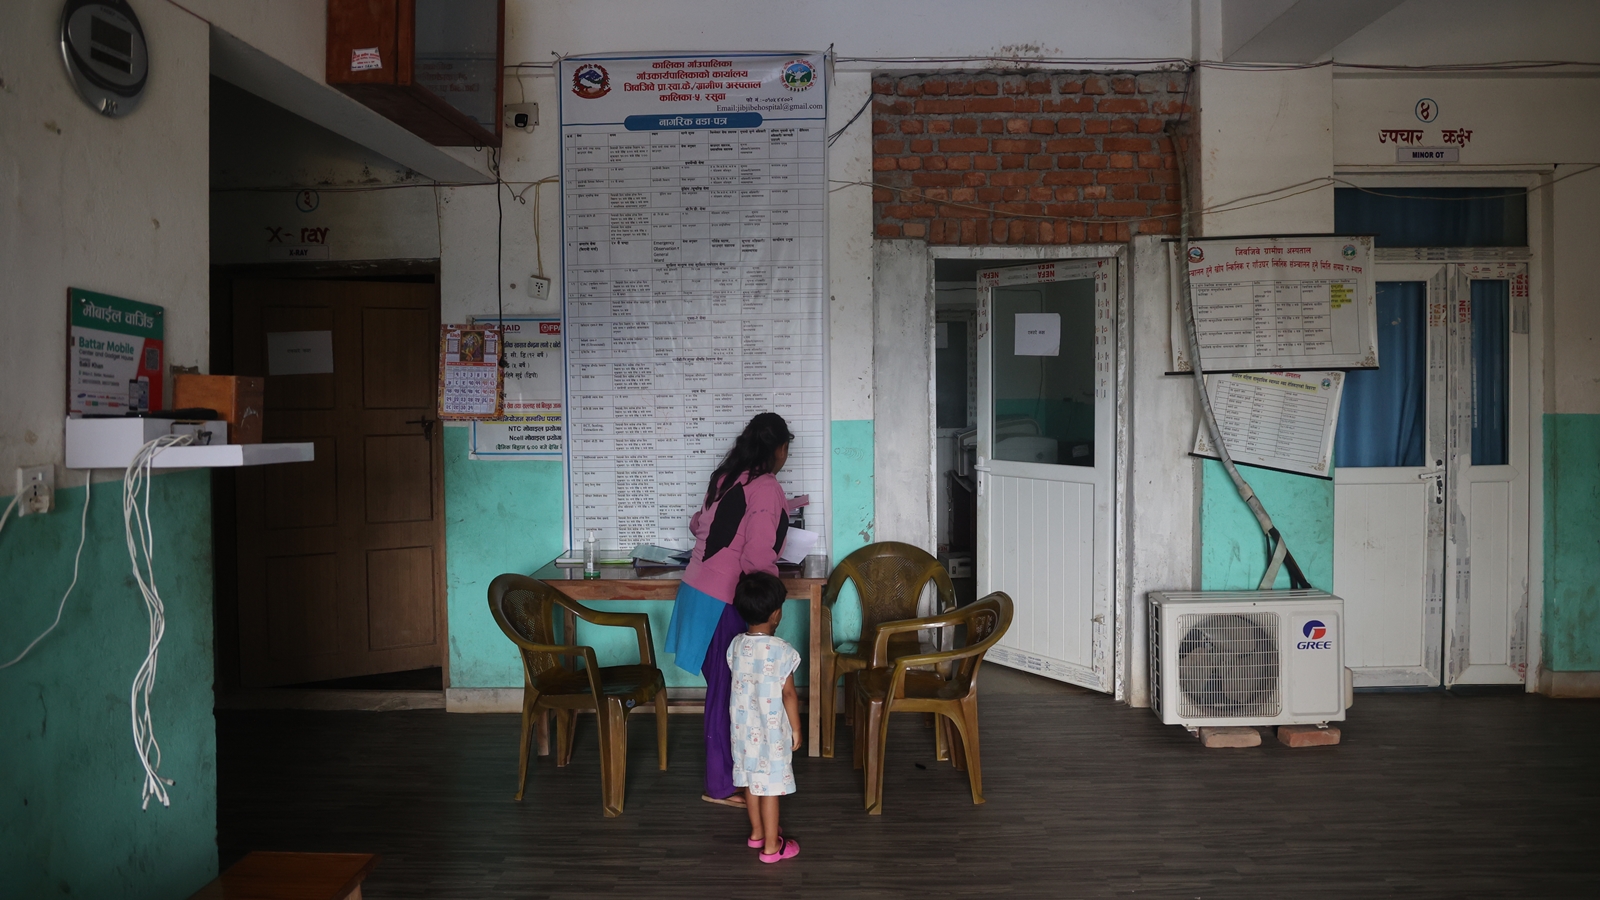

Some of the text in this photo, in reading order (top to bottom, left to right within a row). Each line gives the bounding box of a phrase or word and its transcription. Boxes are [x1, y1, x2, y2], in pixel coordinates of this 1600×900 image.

[652, 60, 685, 69] कालिका
[712, 69, 748, 78] कार्यालय
[624, 82, 654, 92] जिवजिवे
[726, 81, 761, 89] अस्पताल
[705, 93, 726, 102] रसुवा
[659, 116, 693, 127] नागरिक
[1378, 127, 1473, 148] उपचार कक्ष
[1412, 151, 1444, 159] MINOR OT
[301, 227, 330, 245] ray
[1287, 247, 1311, 255] अस्पताल
[1037, 270, 1055, 279] NEFA
[1516, 274, 1524, 297] NEFA
[82, 301, 121, 323] मोबाईल
[79, 336, 134, 354] Battar Mobile
[1297, 641, 1332, 650] GREE
